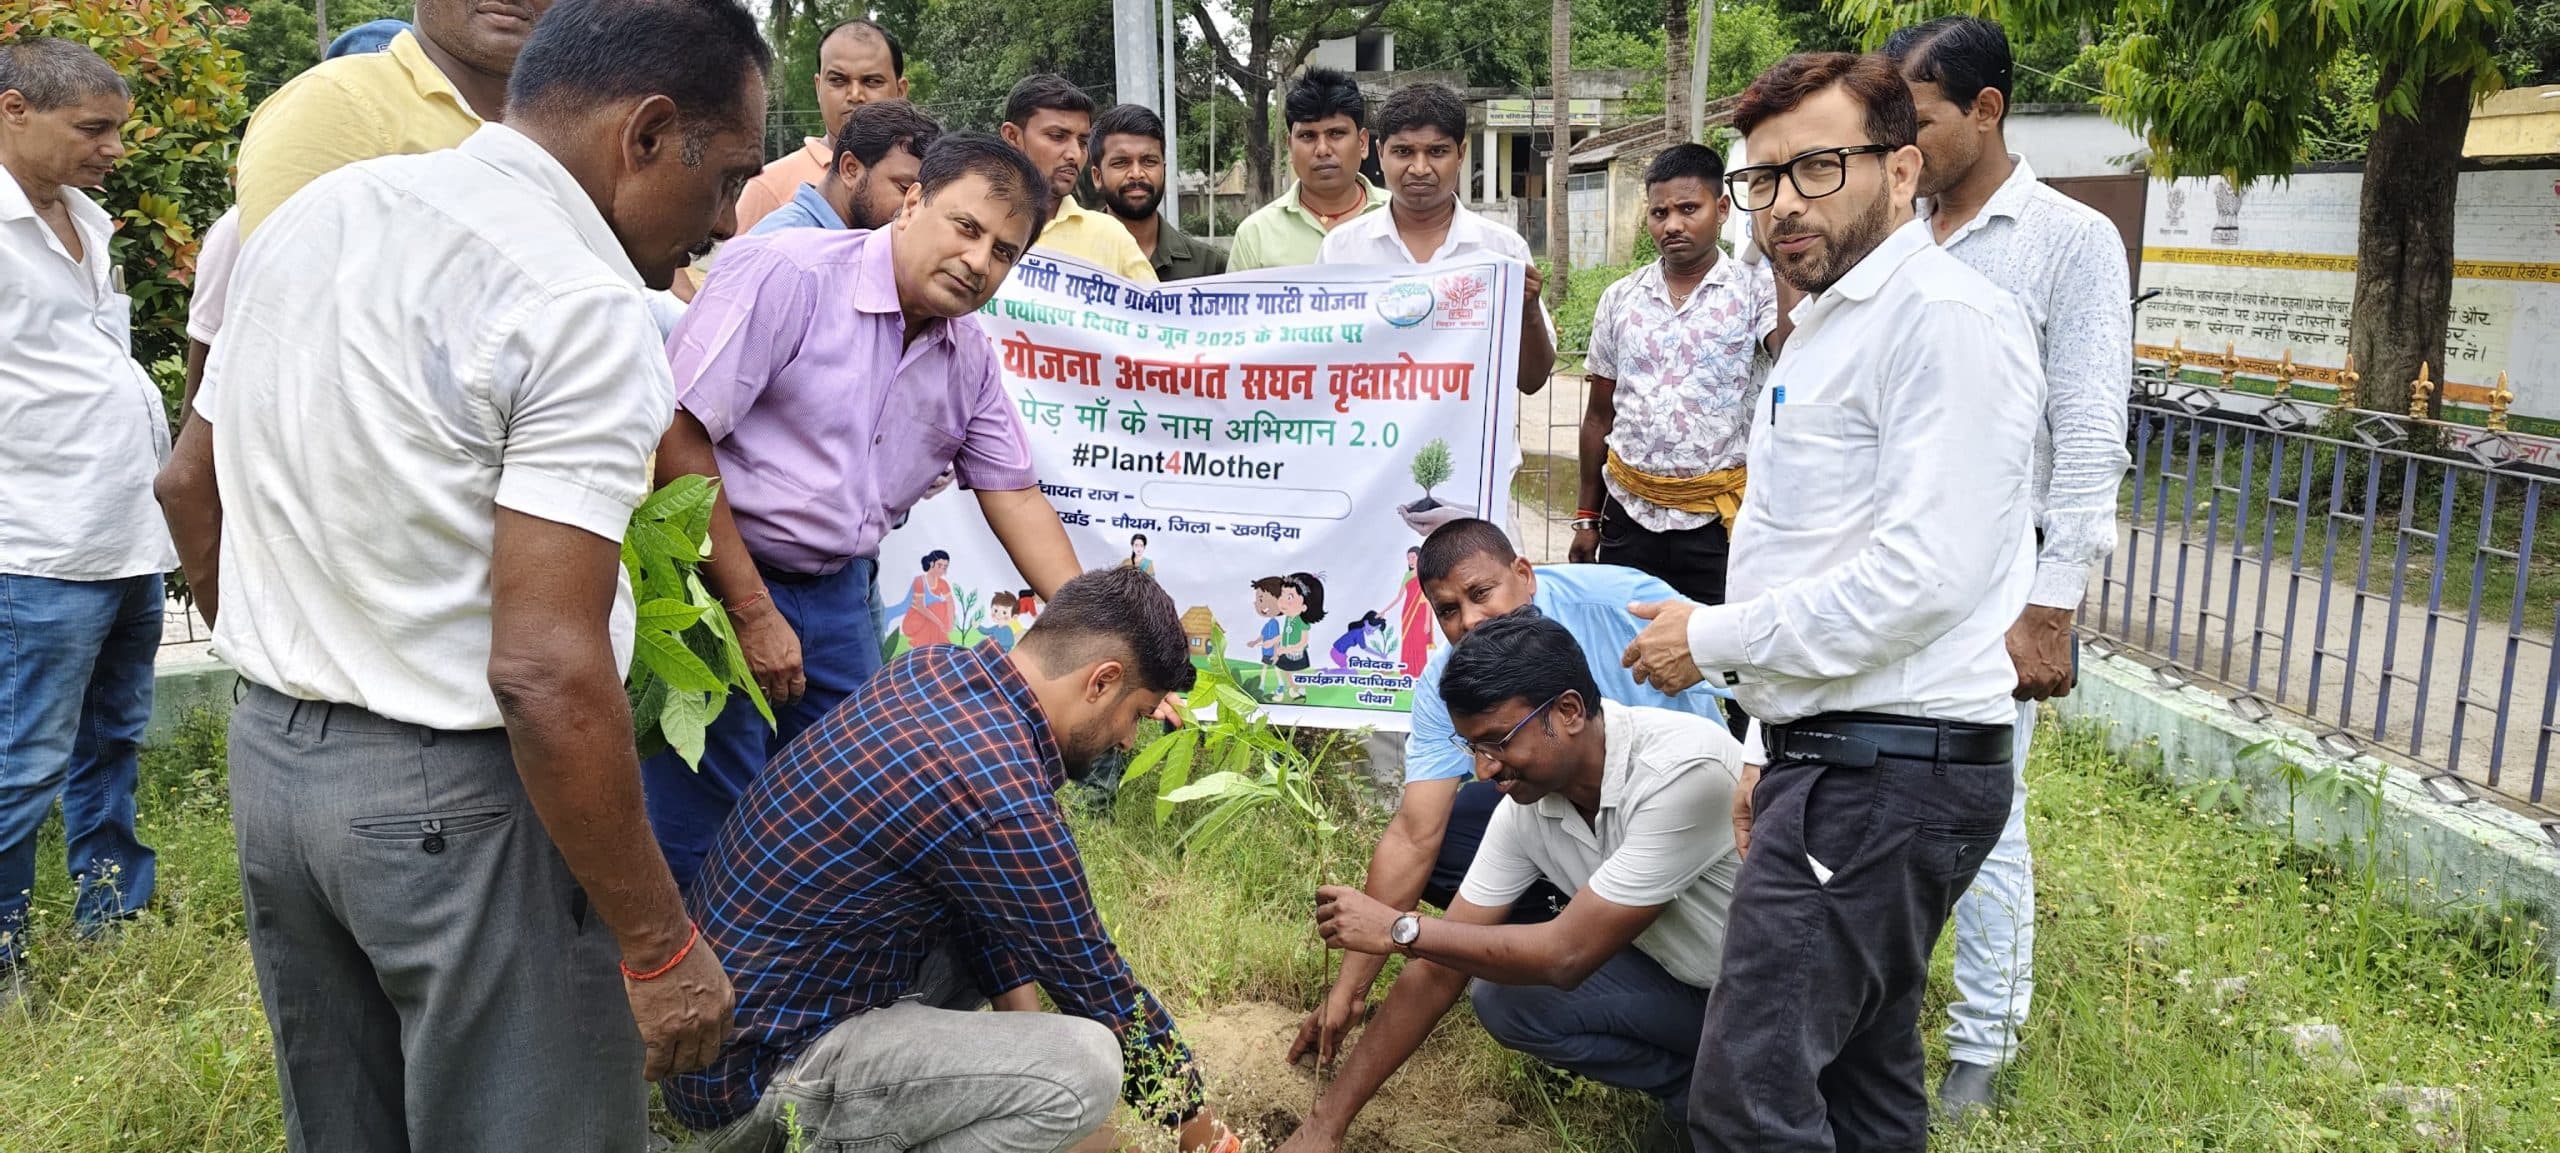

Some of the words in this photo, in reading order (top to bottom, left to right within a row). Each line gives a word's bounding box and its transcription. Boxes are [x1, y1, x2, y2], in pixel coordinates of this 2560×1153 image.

[1018, 258, 1060, 294] गाँधी
[1066, 272, 1120, 305] राष्ट्रीय
[1125, 286, 1182, 315] ग्रामीण
[1188, 287, 1249, 316] रोजगार
[1255, 286, 1304, 315] गारंटी
[1309, 286, 1368, 312] योजना
[1004, 298, 1076, 328] पर्यावरण
[1082, 309, 1131, 337] दिवस
[1136, 321, 1150, 339] 5
[1157, 323, 1190, 349] जून
[1196, 330, 1246, 347] 2025
[1254, 325, 1272, 343] के
[1280, 325, 1334, 343] अवसर
[1341, 323, 1364, 343] पर
[2235, 308, 2249, 320] पर
[2253, 309, 2290, 328] अपने
[2459, 306, 2491, 326] और
[2184, 320, 2200, 331] का
[2207, 320, 2245, 336] सेवन
[2250, 324, 2282, 342] नहीं
[2287, 330, 2330, 345] करने
[1001, 330, 1101, 387] योजना
[1115, 353, 1230, 400] अन्तर्गत
[1239, 363, 1317, 400] सघन
[1327, 351, 1475, 413] वृक्षारोपण
[1018, 388, 1065, 436] पेड़
[1074, 396, 1110, 433] माँ
[1118, 400, 1148, 436] के
[1158, 413, 1213, 441] नाम
[1225, 410, 1337, 446] अभियान
[1350, 420, 1399, 448] 2.0
[1072, 442, 1285, 480] #Plant4Mother
[1088, 488, 1119, 503] राज
[1168, 516, 1211, 535] जिला
[1231, 522, 1302, 543] खगड़िया
[1349, 656, 1395, 670] निवेदक
[1294, 674, 1345, 688] कार्यक्रम
[1349, 674, 1413, 688] पदाधिकारी
